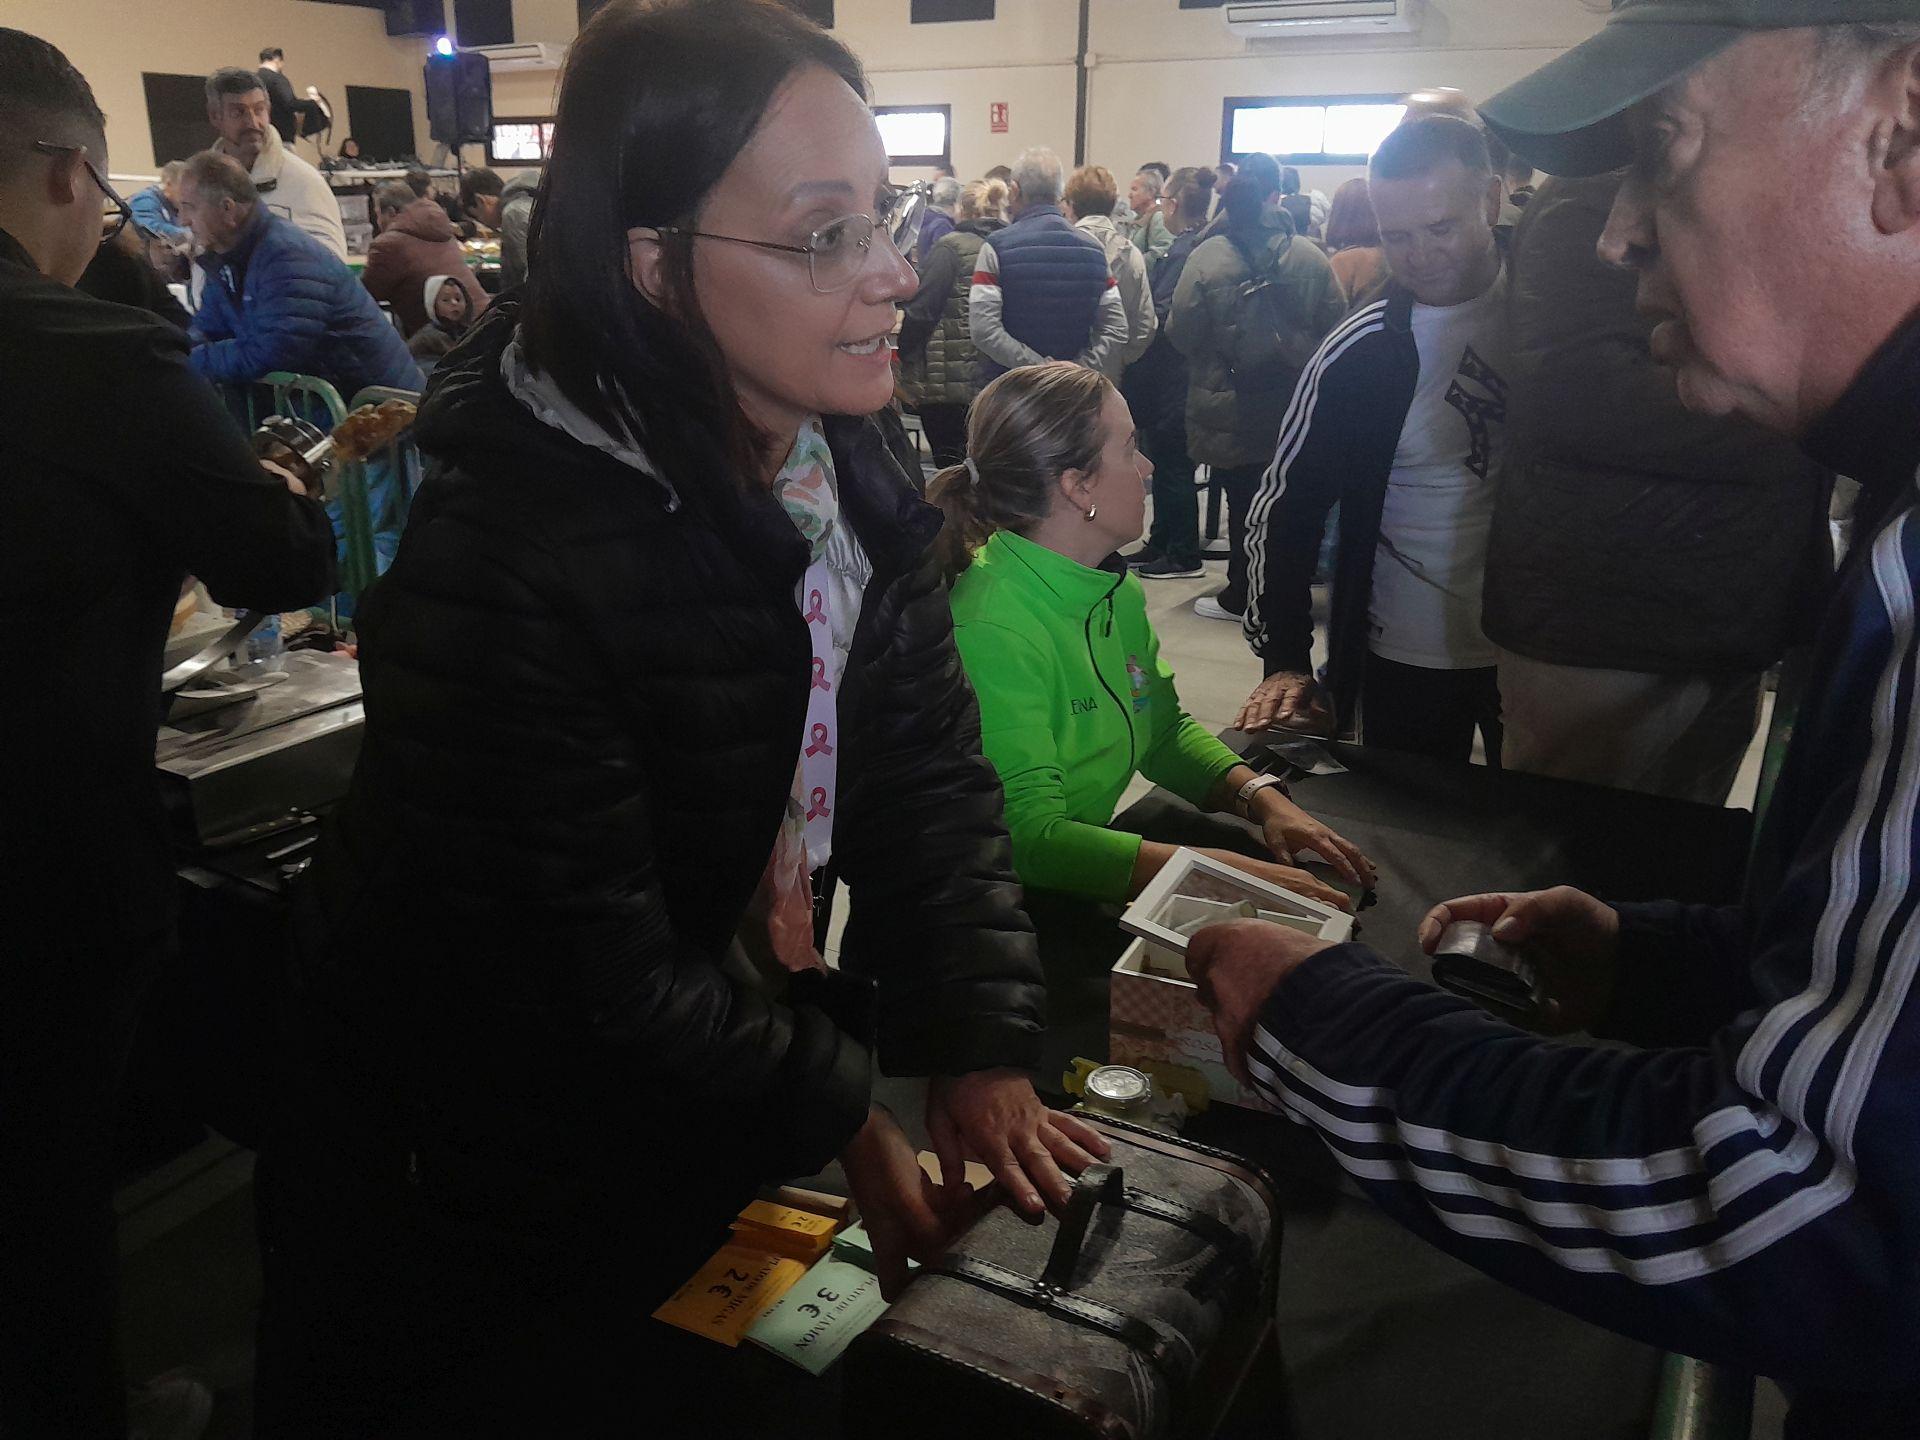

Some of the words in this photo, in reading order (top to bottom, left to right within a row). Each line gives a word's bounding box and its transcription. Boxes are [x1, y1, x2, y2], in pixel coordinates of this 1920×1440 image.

[723, 1267, 750, 1282] 2
[816, 1287, 840, 1302] 3
[797, 1303, 821, 1319] €
